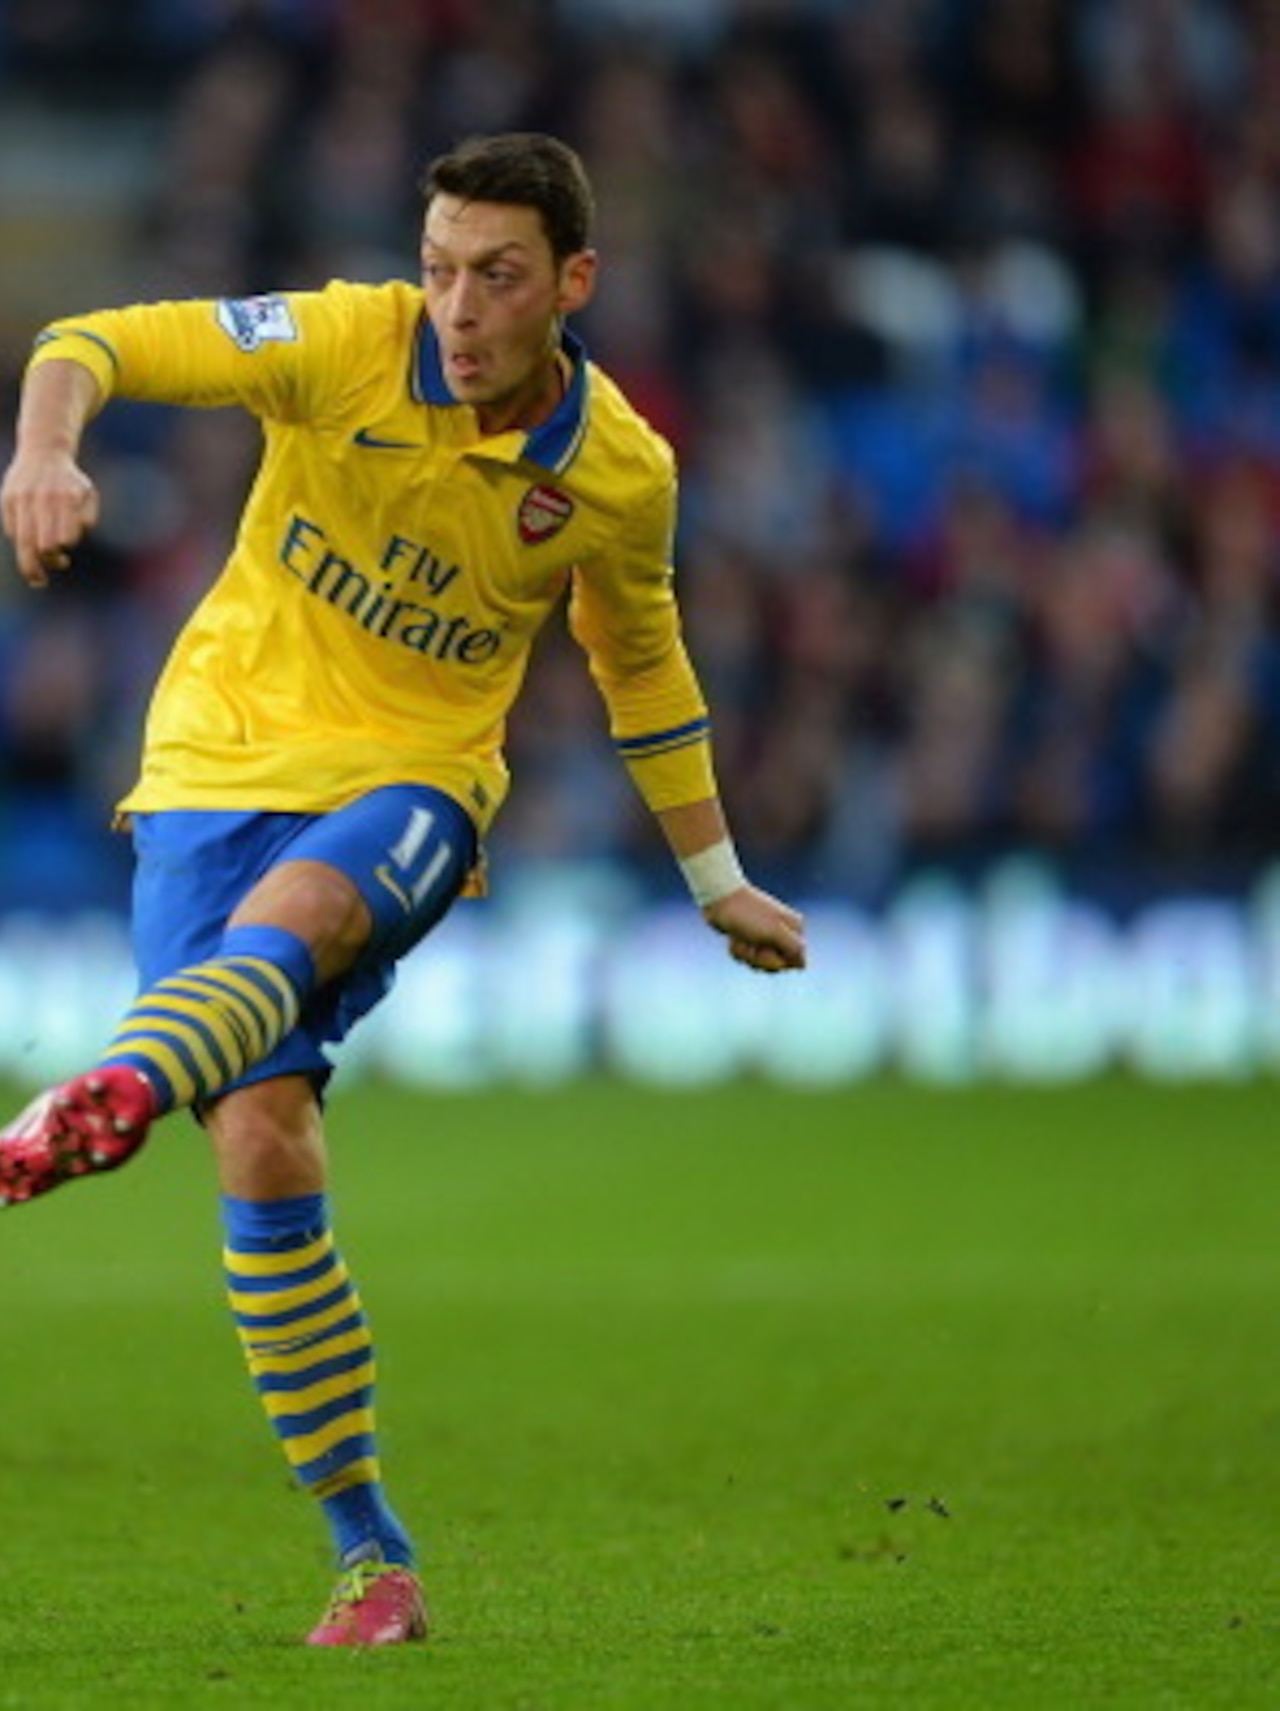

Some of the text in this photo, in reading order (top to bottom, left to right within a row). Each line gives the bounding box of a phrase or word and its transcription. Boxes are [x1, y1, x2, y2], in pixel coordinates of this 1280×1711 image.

[278, 512, 508, 664] Emirate
[379, 534, 460, 597] Fly
[387, 806, 451, 907] 11
